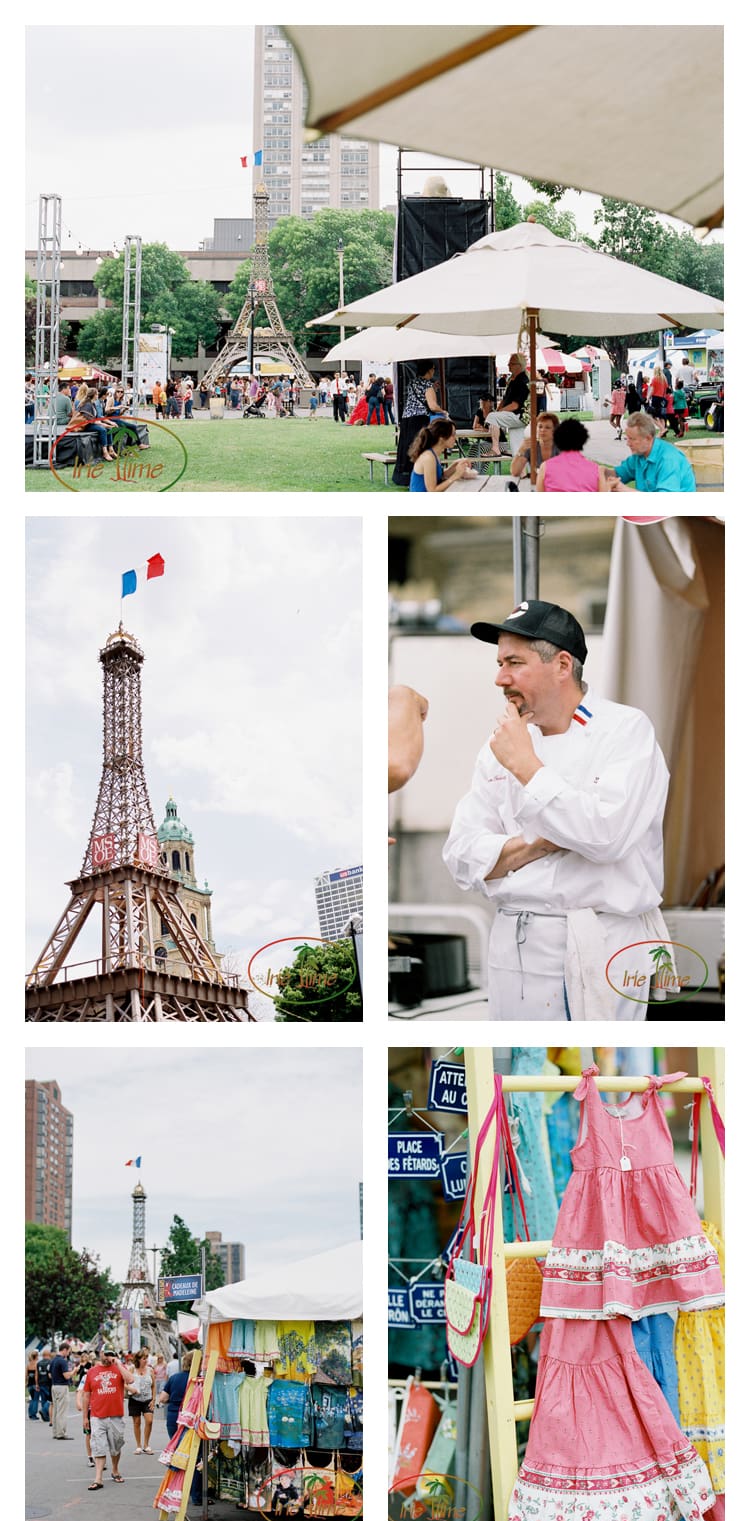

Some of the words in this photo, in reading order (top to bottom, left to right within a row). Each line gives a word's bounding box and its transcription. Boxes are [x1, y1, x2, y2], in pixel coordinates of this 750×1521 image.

[94, 836, 113, 852] MS
[94, 847, 114, 863] OE
[439, 1071, 465, 1087] ATTE
[441, 1089, 457, 1104] AU
[396, 1140, 423, 1153] PLACE
[422, 1290, 435, 1298] NE
[421, 1309, 433, 1317] LE
